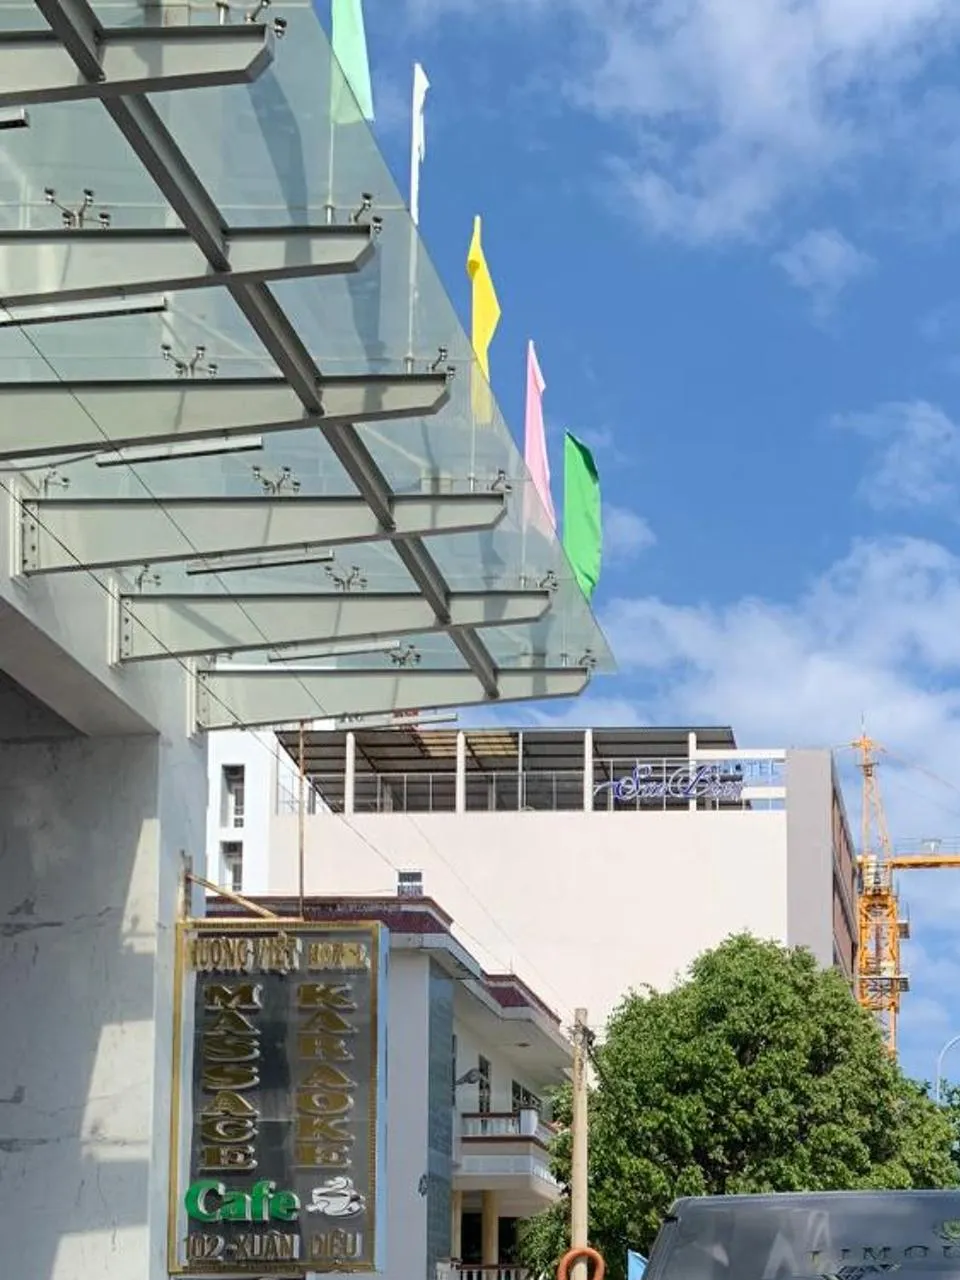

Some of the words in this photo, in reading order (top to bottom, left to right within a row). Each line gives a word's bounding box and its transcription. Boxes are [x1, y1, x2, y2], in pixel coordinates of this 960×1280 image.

[200, 983, 263, 1170] MASSAGE
[296, 982, 358, 1169] KARAOKE
[185, 1180, 300, 1222] Cafe
